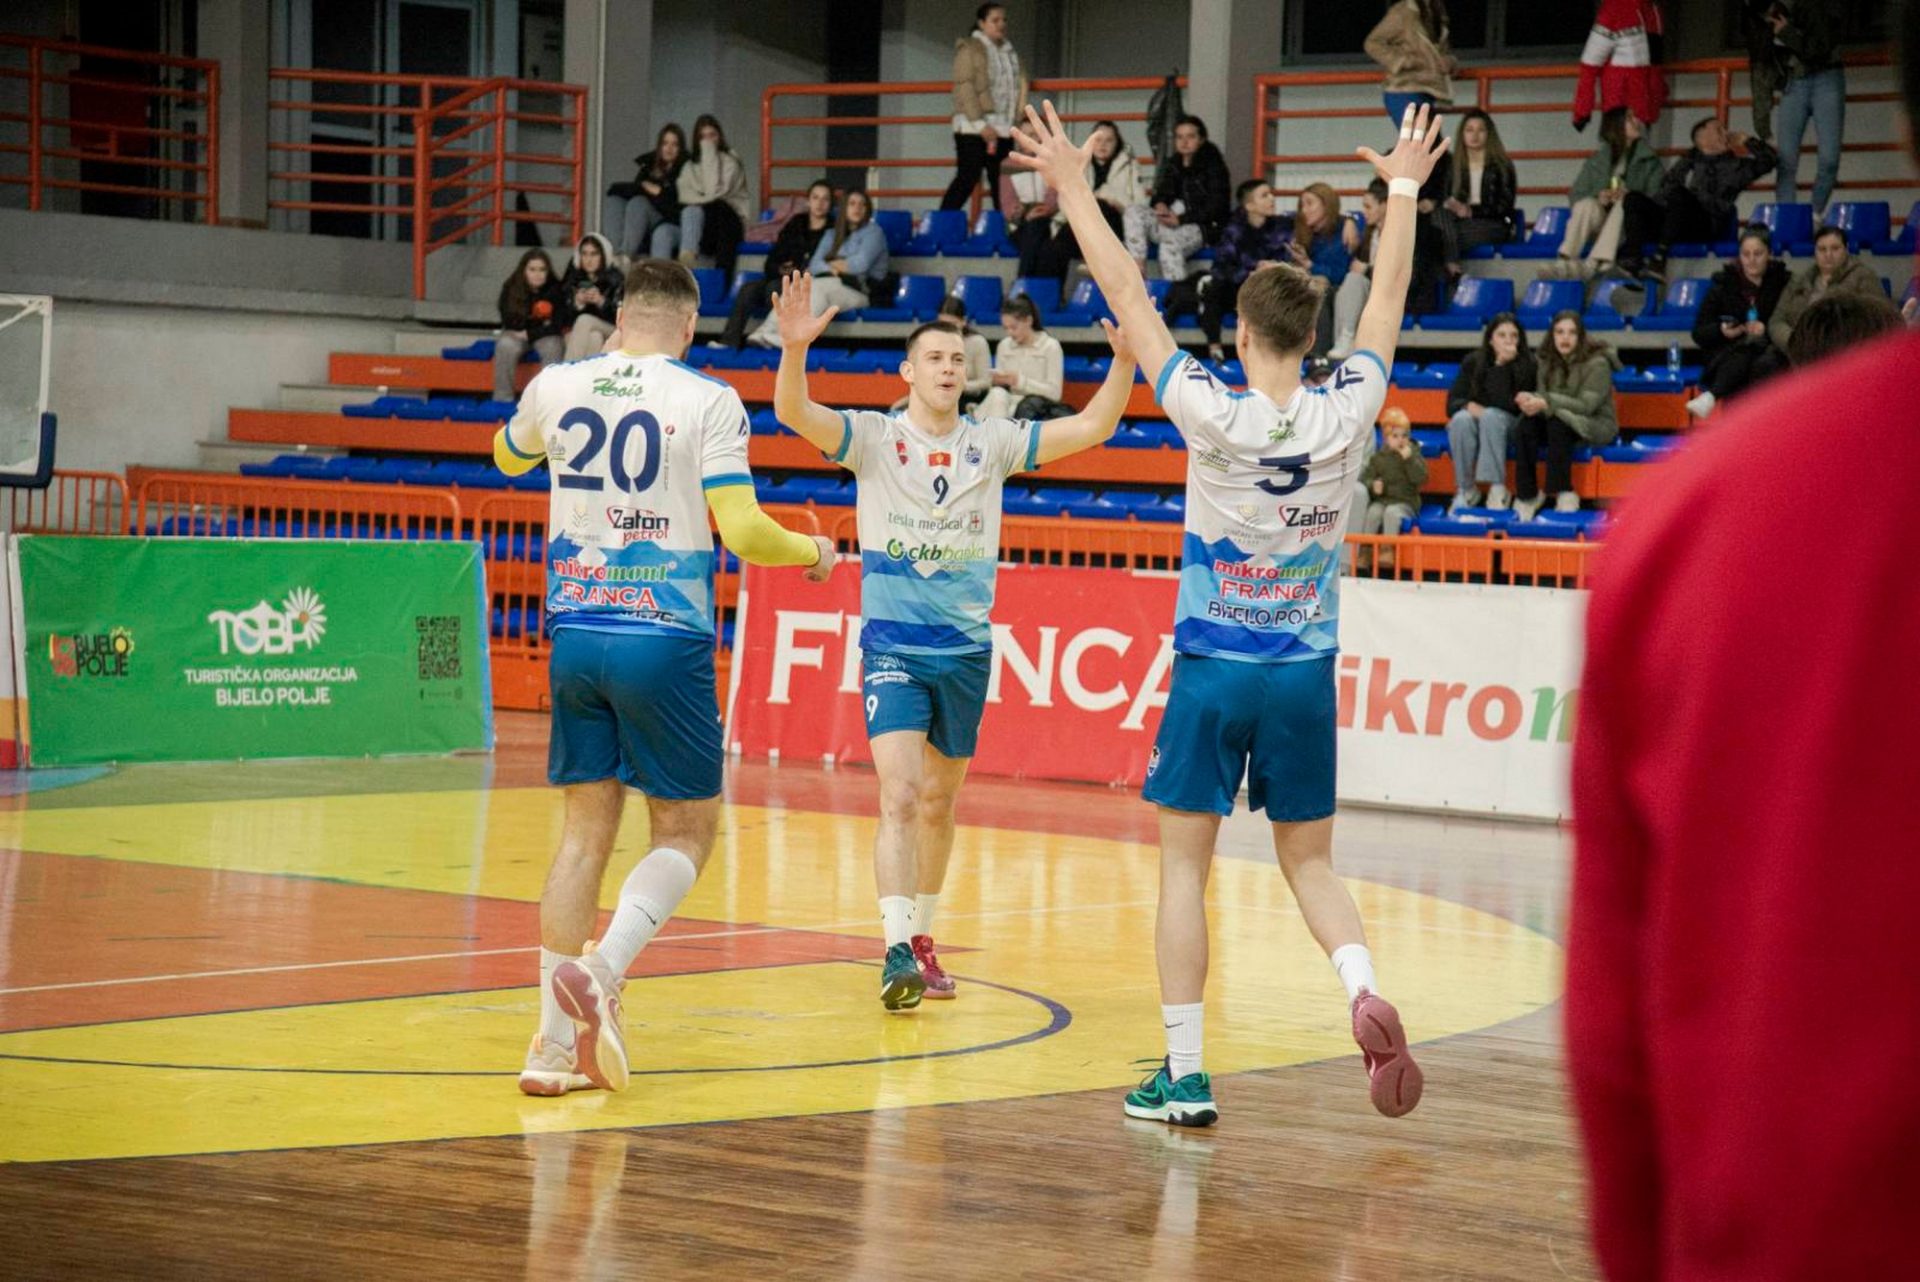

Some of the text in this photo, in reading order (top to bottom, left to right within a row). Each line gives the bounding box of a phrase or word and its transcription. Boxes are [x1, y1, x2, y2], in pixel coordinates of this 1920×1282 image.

[558, 406, 661, 493] 20
[1254, 452, 1312, 495] 3
[933, 474, 949, 504] 9
[613, 508, 669, 529] Zaton
[888, 512, 963, 530] tesla medical
[1285, 506, 1339, 528] Zaton
[623, 527, 669, 546] petrol
[558, 582, 657, 609] FRANCA
[1221, 580, 1317, 600] FRANCA
[74, 635, 129, 656] BIJELO
[76, 655, 129, 676] POLJE
[184, 666, 358, 684] TURISTIČKA ORGANIZACIJA
[216, 687, 331, 706] BIJELO POLJE
[866, 694, 878, 722] 9
